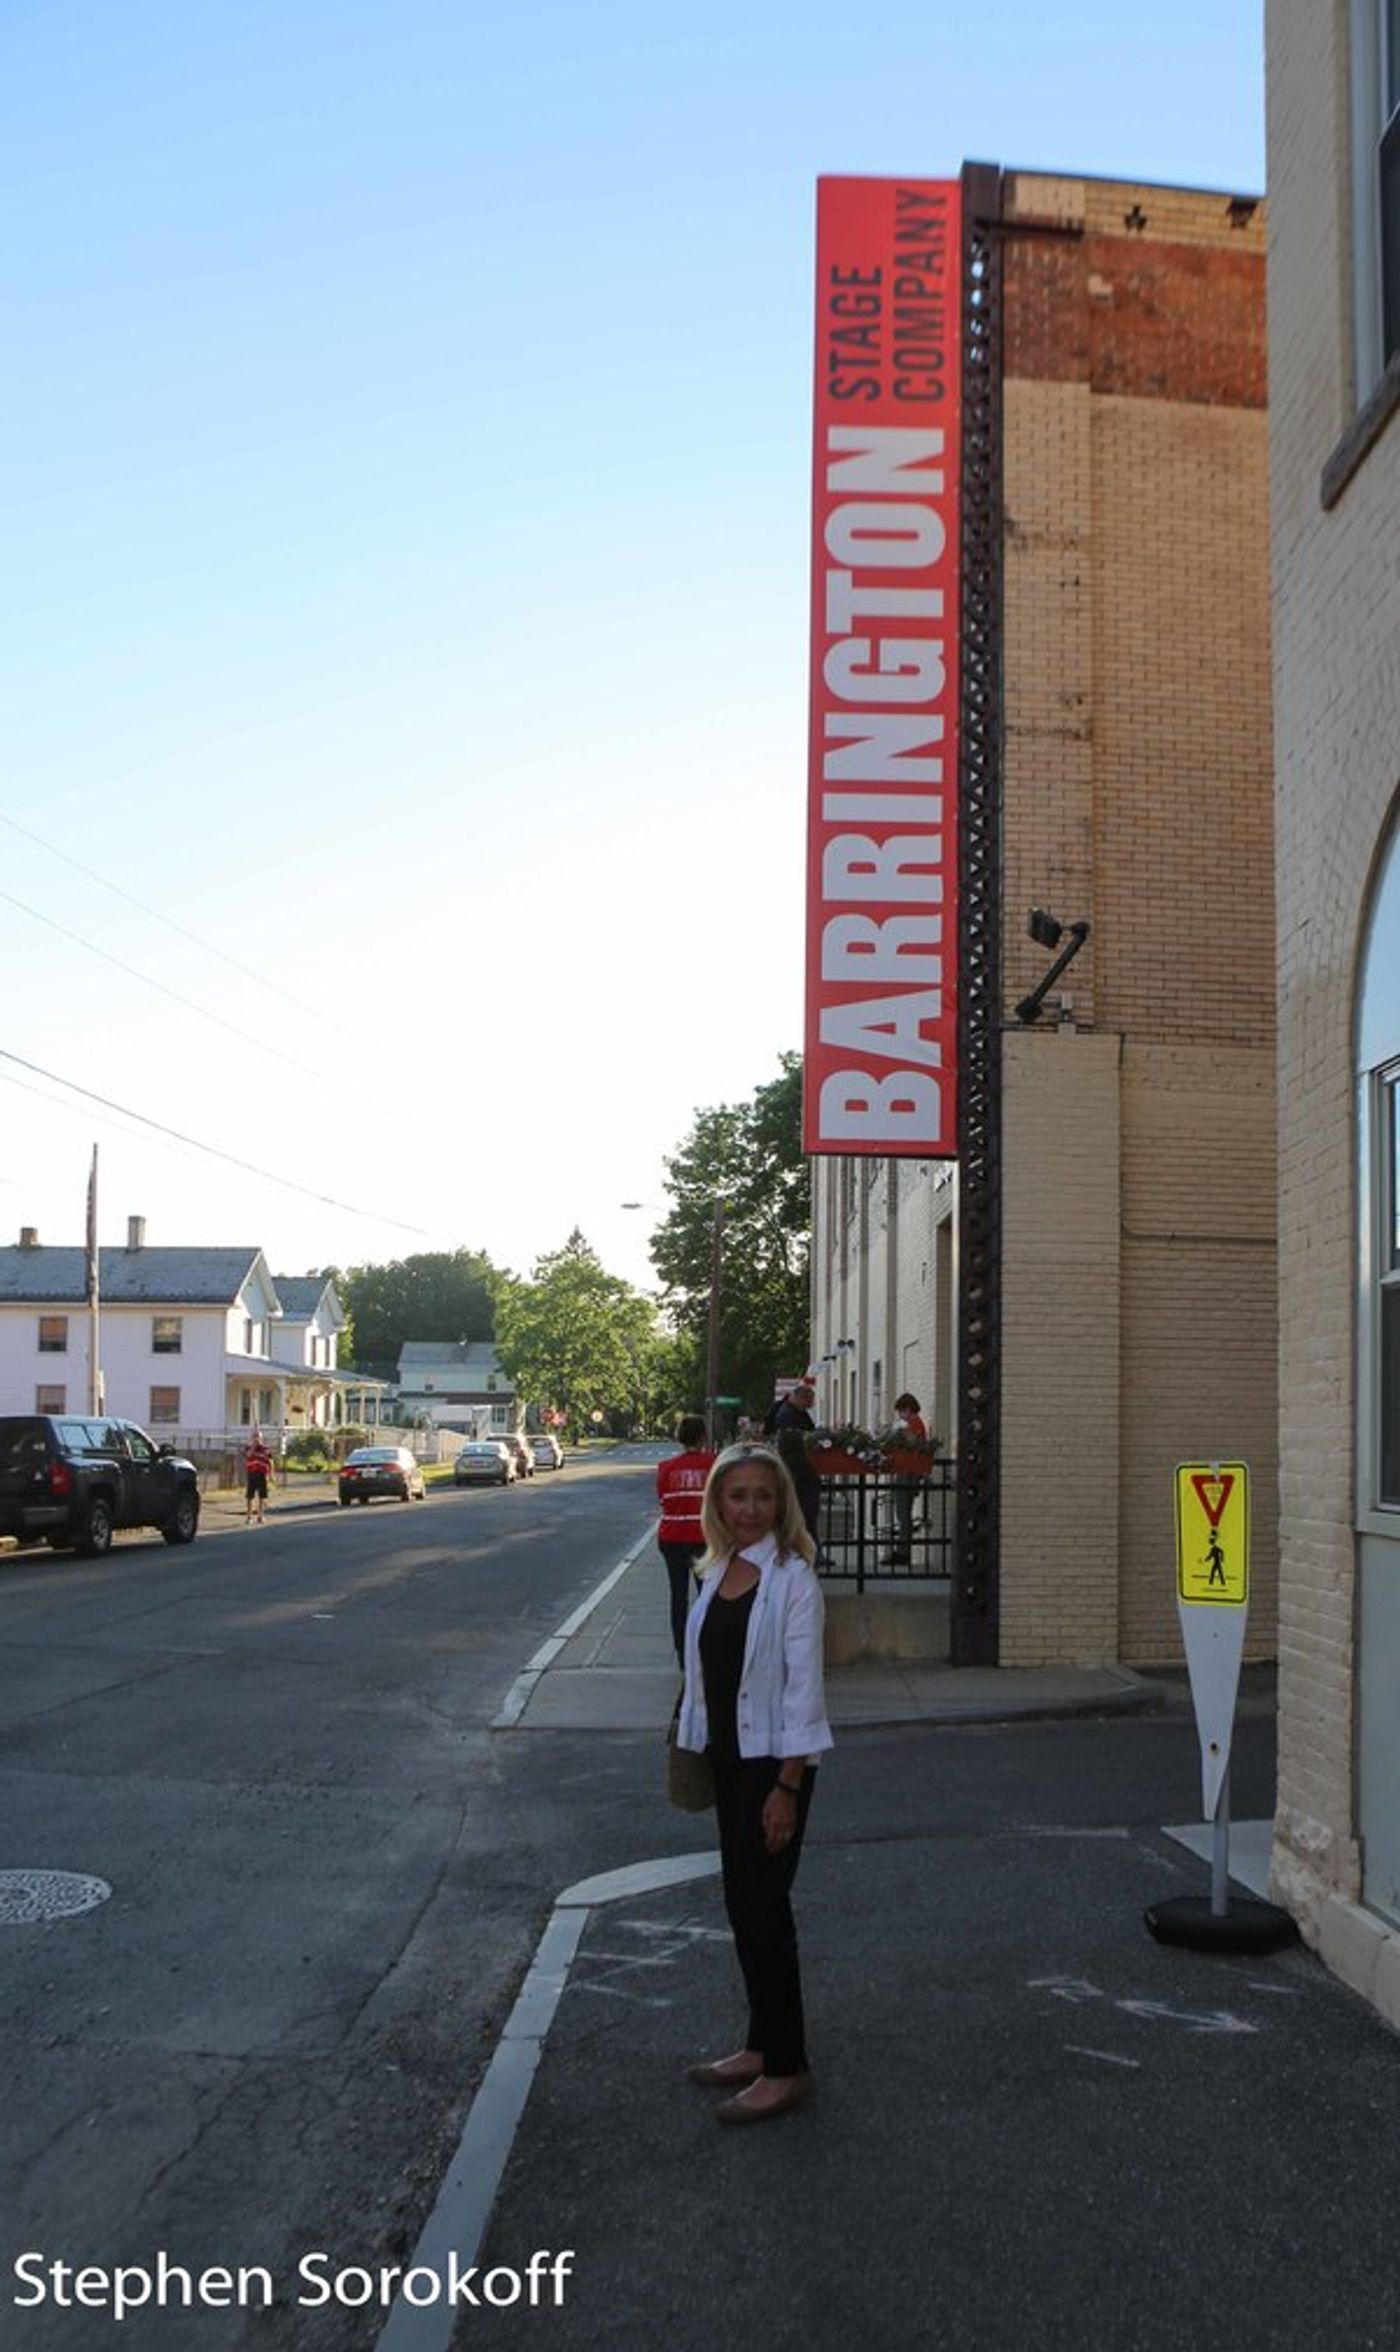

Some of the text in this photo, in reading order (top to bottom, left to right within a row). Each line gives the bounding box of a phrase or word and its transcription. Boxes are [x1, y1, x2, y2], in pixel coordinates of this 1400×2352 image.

[828, 264, 883, 402] STAGE
[892, 186, 947, 403] COMPANY
[819, 425, 946, 1142] BARRINGTON
